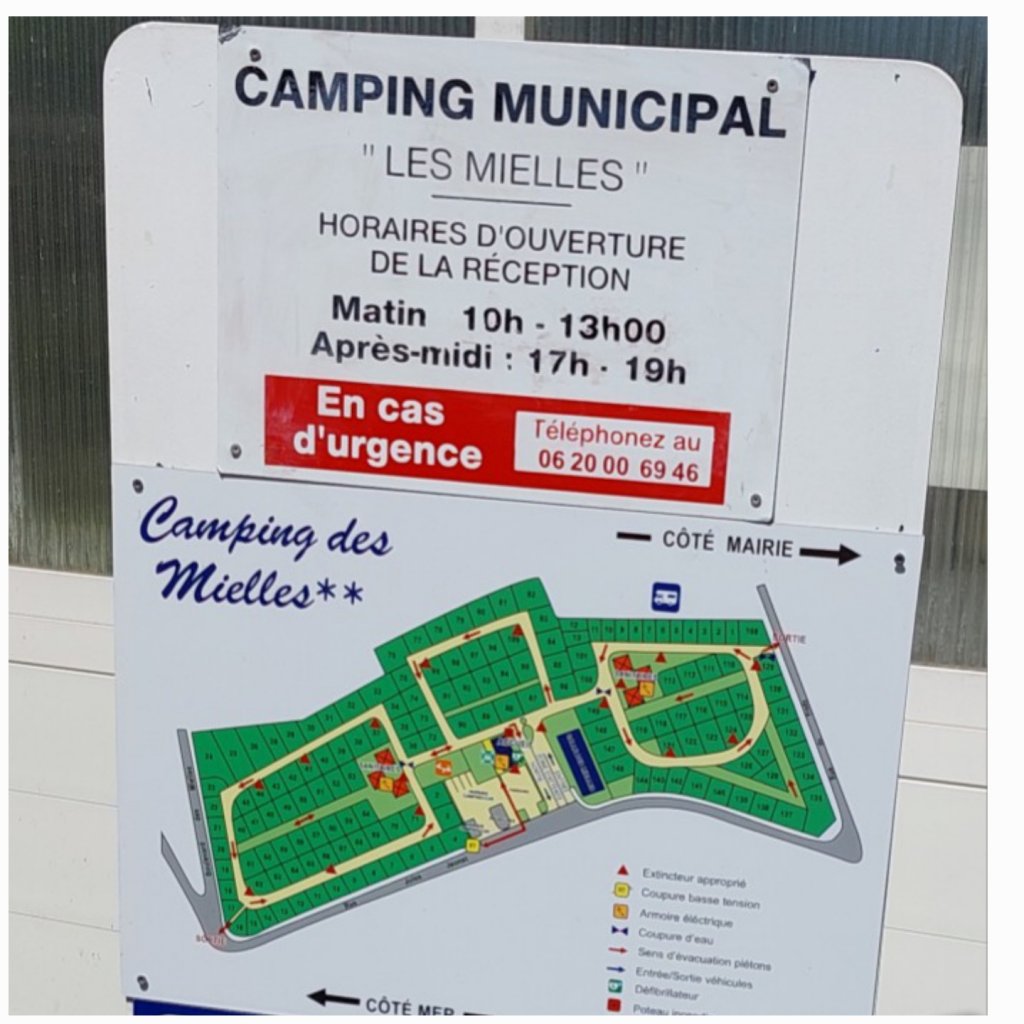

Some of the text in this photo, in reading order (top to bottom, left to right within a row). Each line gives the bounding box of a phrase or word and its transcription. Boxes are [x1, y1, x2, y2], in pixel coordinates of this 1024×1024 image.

[233, 65, 788, 139] CAMPING MUNICIPAL
[385, 146, 453, 181] LES
[465, 151, 625, 191] MIELLES
[319, 212, 686, 261] HORAIRES D'OUVERTURE
[370, 250, 631, 291] DE LA RÉCEPTION
[331, 294, 427, 328] Matin
[463, 307, 523, 335] 10h
[559, 314, 666, 344] 13h00
[311, 331, 492, 371] Après-midi
[529, 350, 589, 377] 17h
[626, 357, 687, 385] 19h
[317, 385, 445, 426] En cas
[293, 425, 483, 470] d'urgence
[534, 418, 701, 452] Téléphonez au
[538, 449, 699, 482] 06 20 00 69 46
[139, 495, 393, 562] Camping des
[662, 527, 794, 558] CÔTÉ MAIRIE
[642, 868, 747, 889] Extincteur approprié
[641, 888, 761, 910] Coupure basse tension
[639, 909, 680, 923] Armoire
[638, 928, 715, 946] Coupure d'eau
[638, 947, 664, 960] Sens
[734, 959, 772, 972] piétons
[634, 984, 700, 1001] Défibrillateur
[635, 967, 754, 990] Entrée/Sortie véhicules
[366, 995, 413, 1015] CÔTÉ
